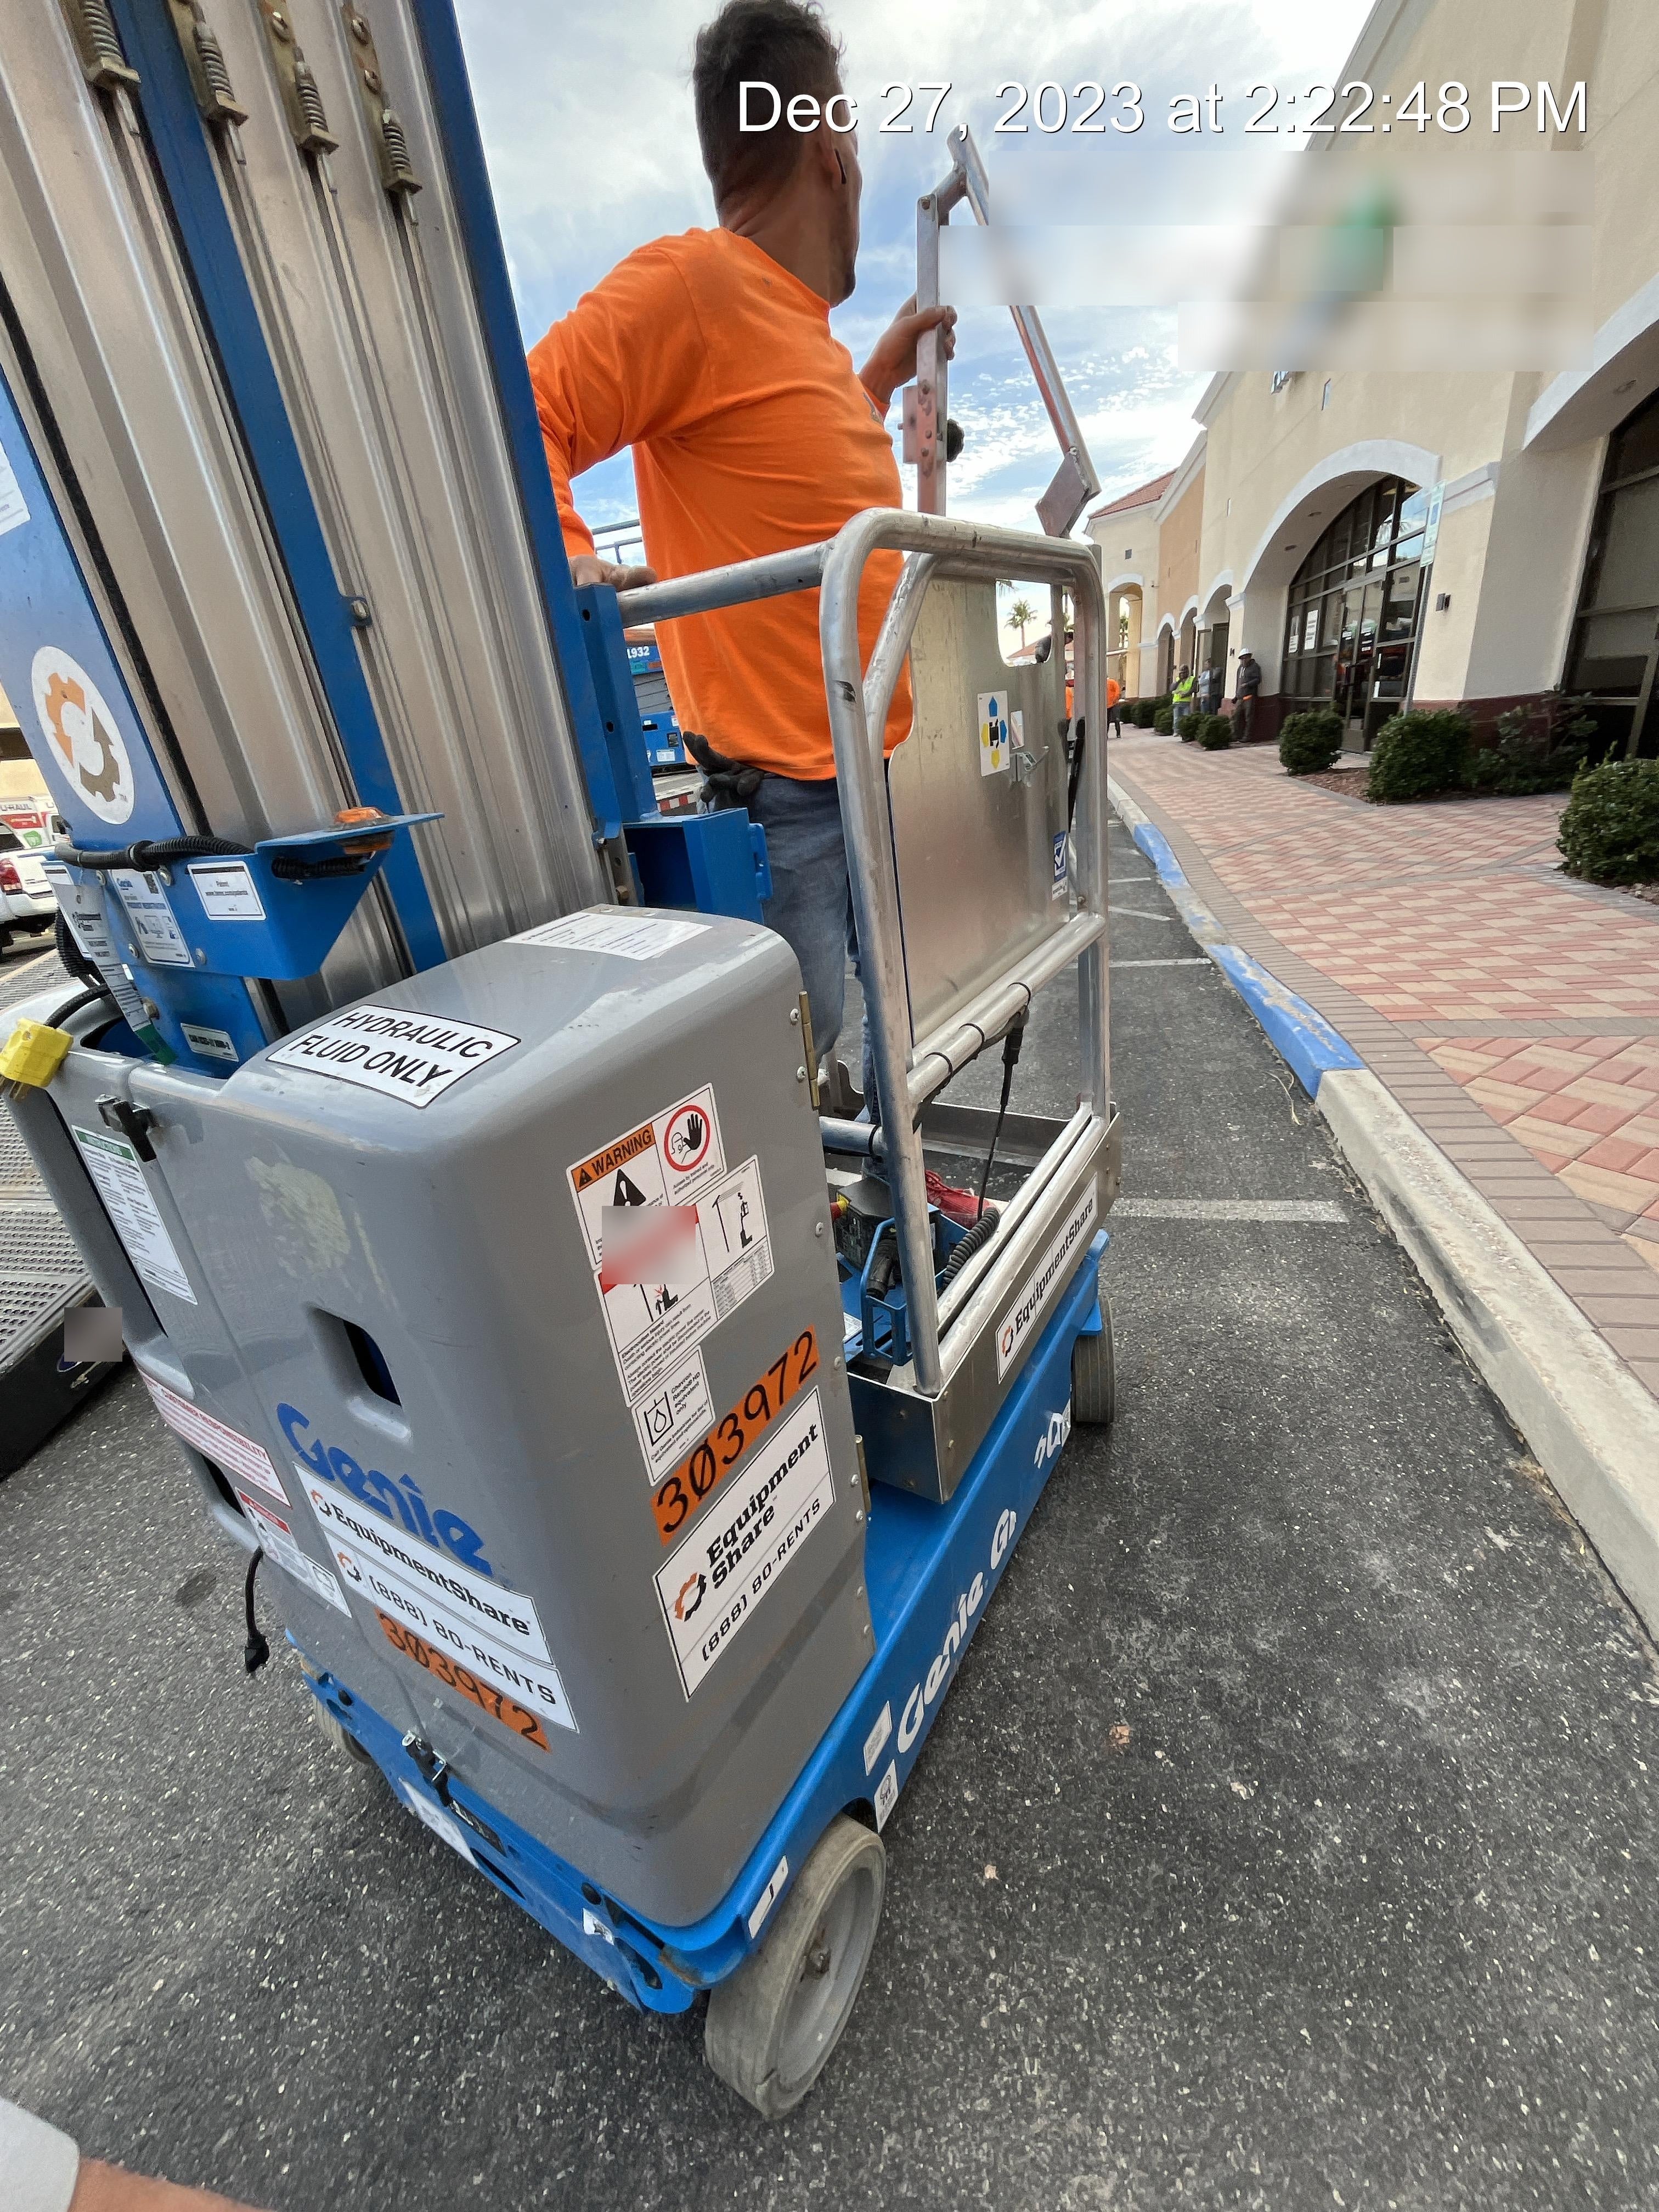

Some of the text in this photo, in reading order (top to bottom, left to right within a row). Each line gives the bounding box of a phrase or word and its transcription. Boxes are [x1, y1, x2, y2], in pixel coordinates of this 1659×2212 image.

[289, 1035, 454, 1087] FLUID ONLY
[332, 1012, 493, 1058] HYDRAULIC
[591, 1130, 652, 1176] WARNING
[1015, 1197, 1093, 1335] EquipmentShare
[657, 1330, 817, 1533] 303972
[672, 1373, 692, 1393] Chevron
[676, 1402, 686, 1414] only
[692, 1372, 700, 1381] HD
[276, 1402, 494, 1578] Genie
[706, 1423, 819, 1568] Equipment
[712, 1505, 775, 1589] Share
[330, 1502, 531, 1637] EquipmentShare
[701, 1498, 820, 1662] (888) 80-RENTS
[368, 1575, 556, 1705] (888) 80-RENTS
[379, 1611, 542, 1749] 303972
[897, 1572, 984, 1753] Genie
